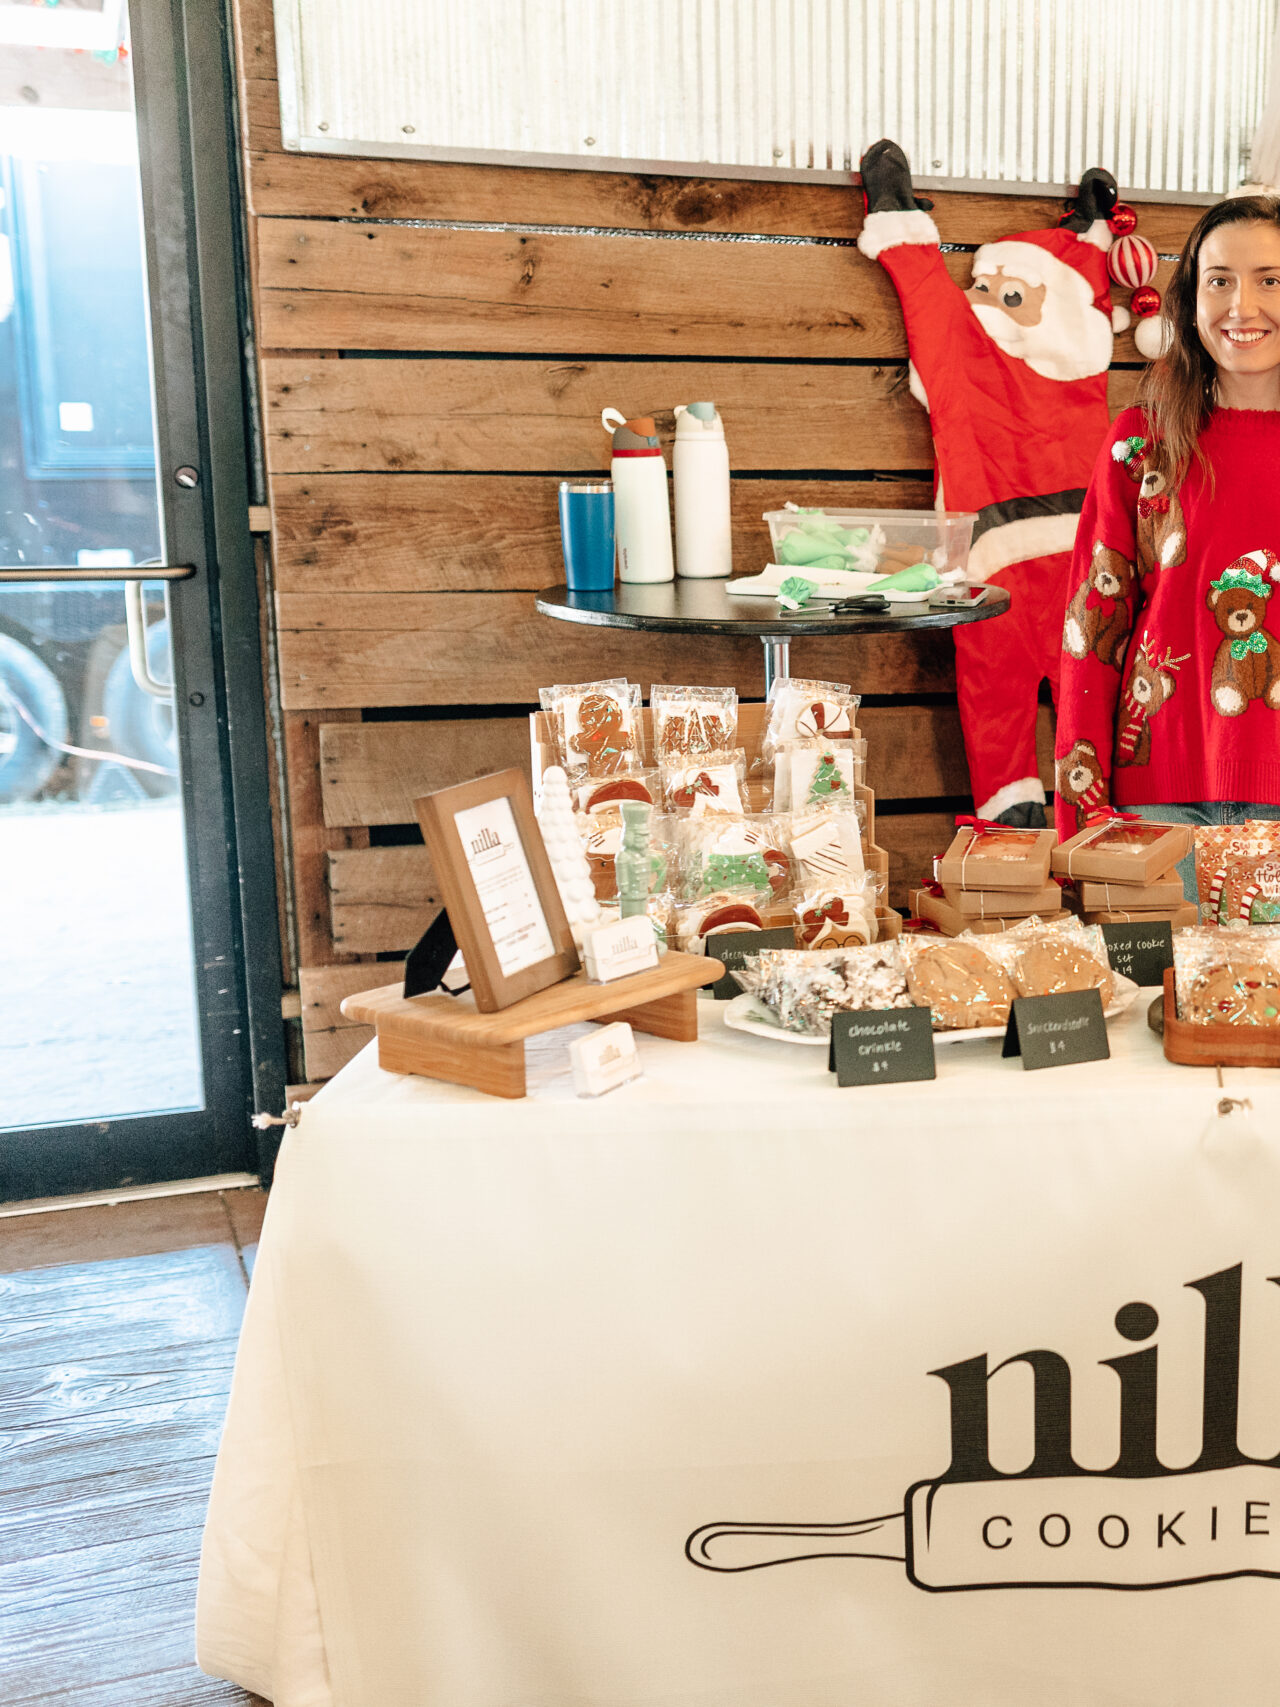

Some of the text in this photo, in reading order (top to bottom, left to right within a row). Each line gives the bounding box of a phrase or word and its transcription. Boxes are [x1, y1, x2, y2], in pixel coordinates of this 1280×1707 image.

[471, 827, 501, 855] nilla
[1106, 939, 1165, 952] oxed cookie
[1116, 953, 1134, 963] set
[982, 1501, 1270, 1550] COOKIE
